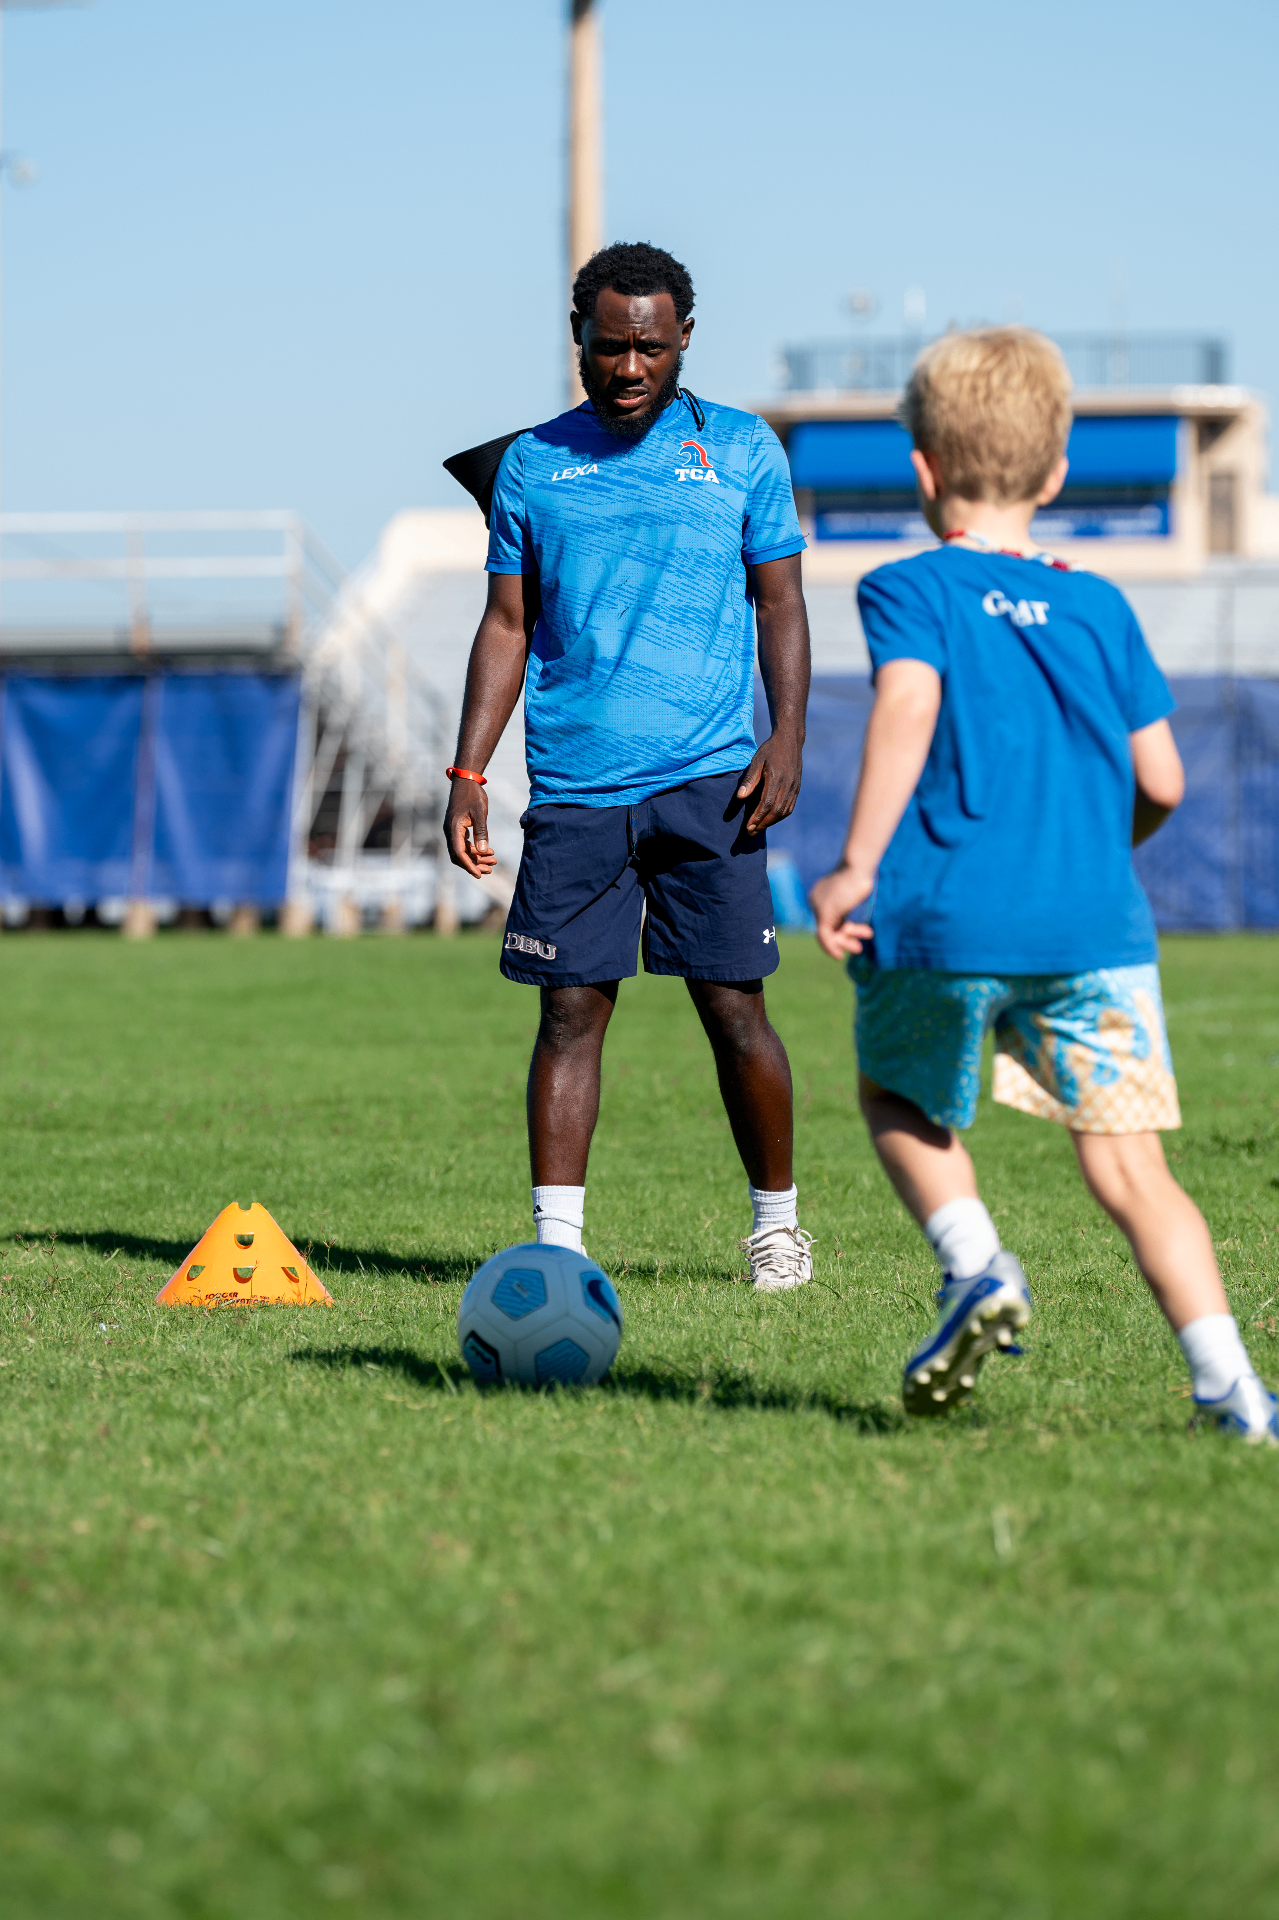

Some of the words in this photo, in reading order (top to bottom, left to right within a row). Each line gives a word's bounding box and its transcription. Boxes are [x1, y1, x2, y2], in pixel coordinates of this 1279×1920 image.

[551, 463, 598, 482] LEXA
[675, 468, 720, 485] TCA
[504, 932, 557, 960] DBU
